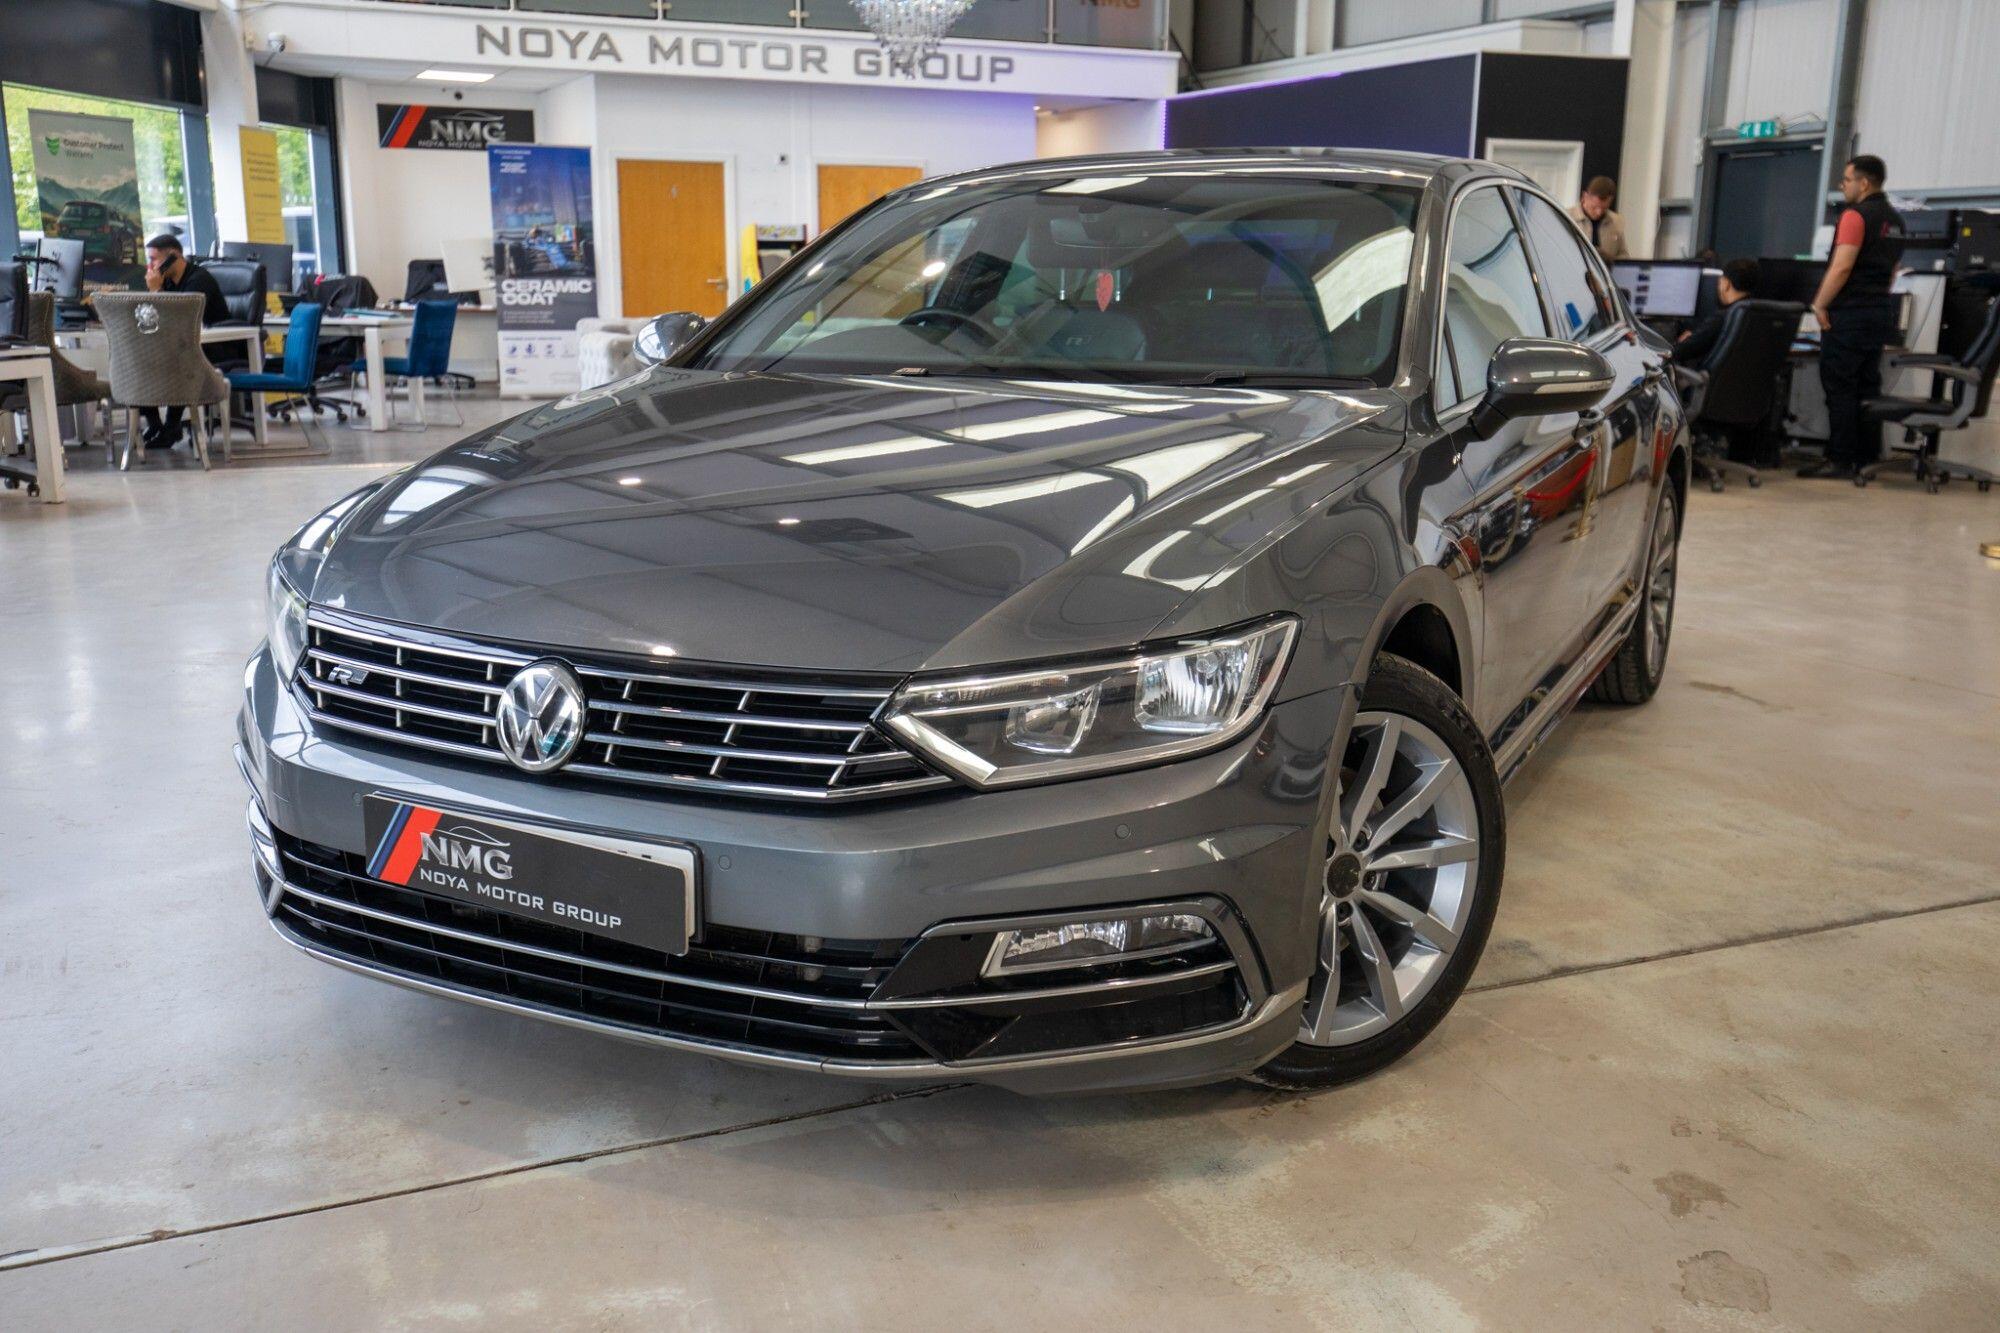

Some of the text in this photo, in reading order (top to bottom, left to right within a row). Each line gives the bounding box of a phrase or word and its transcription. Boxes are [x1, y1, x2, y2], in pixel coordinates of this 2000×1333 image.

[476, 24, 622, 63] NOYA
[649, 35, 828, 74] MOTOR
[429, 118, 507, 143] NMG
[63, 138, 97, 149] Customer
[417, 139, 483, 150] NOYA MOTOR
[501, 278, 592, 293] CERAMIC
[502, 291, 558, 306] COAT
[419, 831, 514, 880] NMG
[419, 867, 622, 929] NOYA MOTOR GROUP
